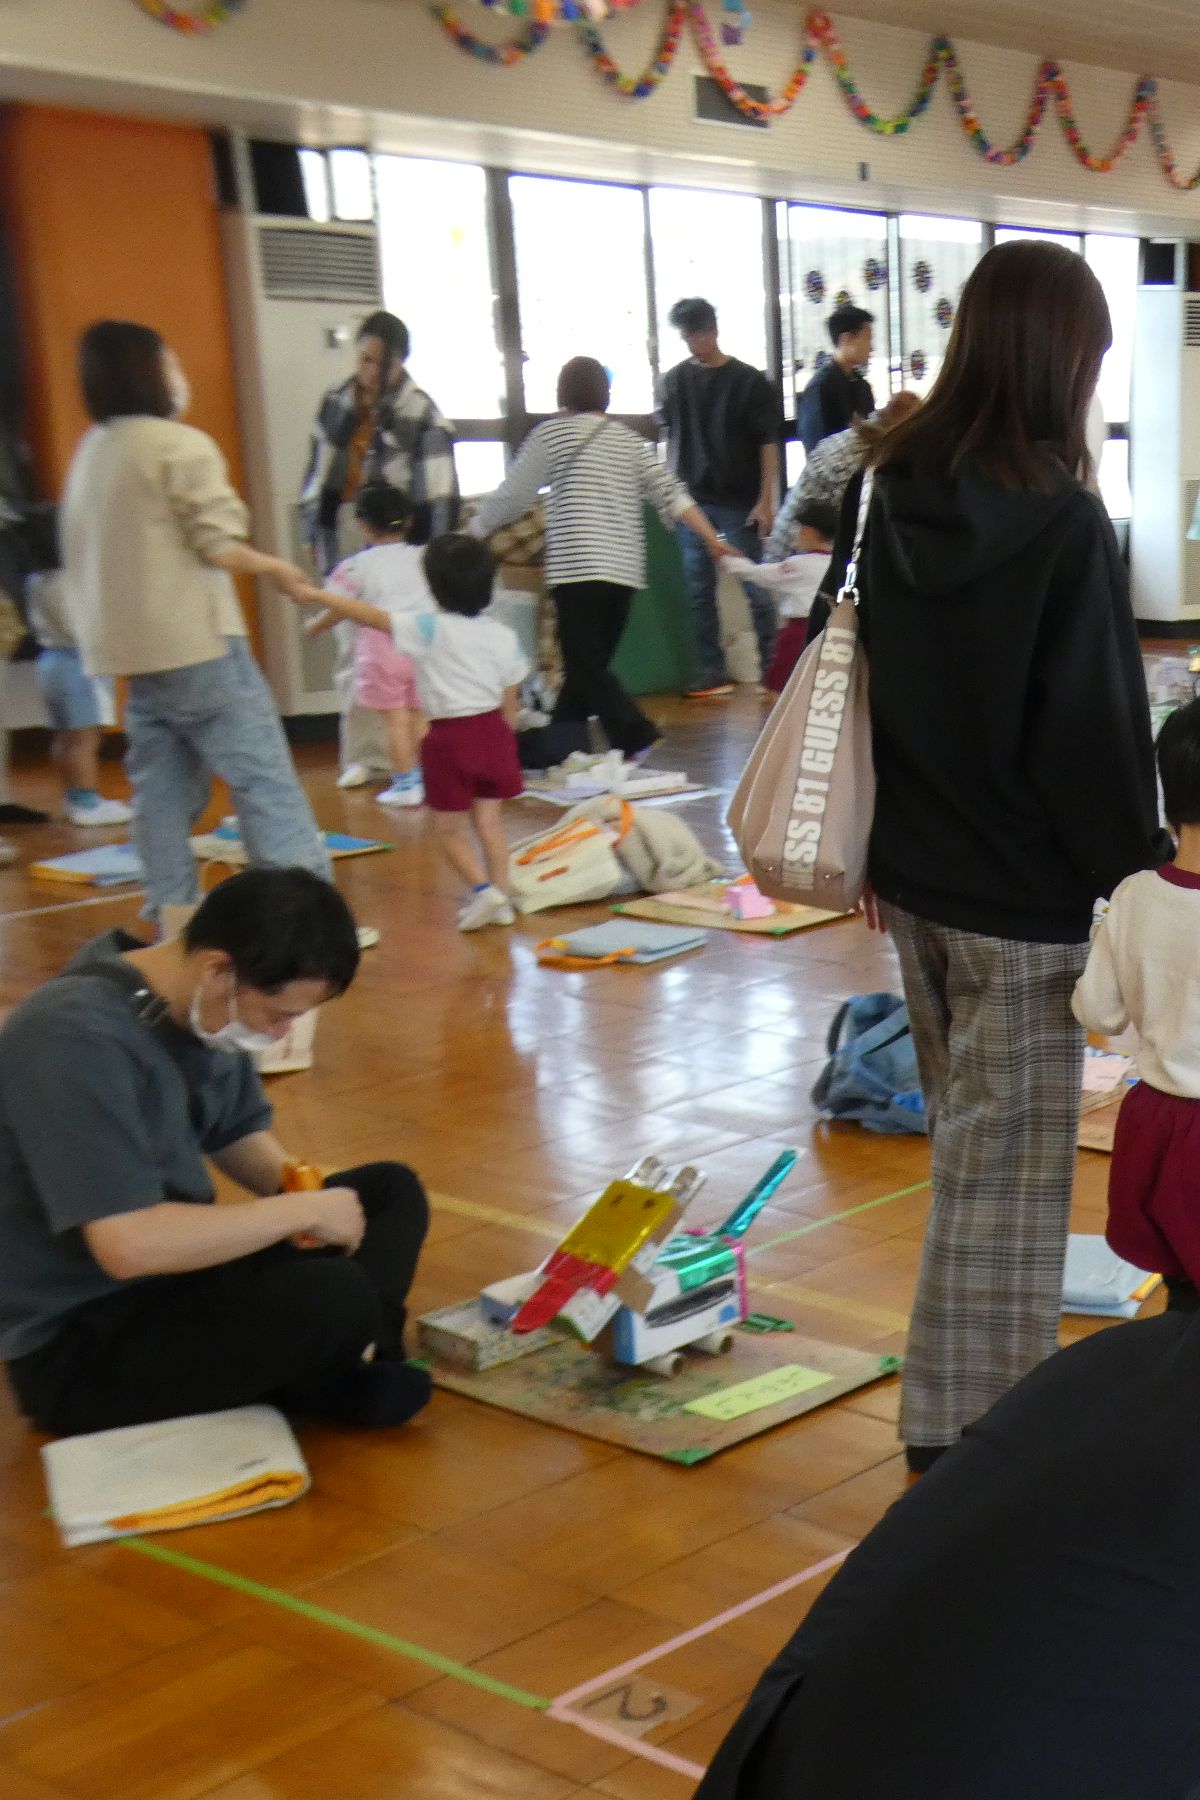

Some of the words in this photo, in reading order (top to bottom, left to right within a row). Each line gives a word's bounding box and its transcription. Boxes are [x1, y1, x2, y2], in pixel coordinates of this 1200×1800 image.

[820, 626, 857, 665] 81
[799, 668, 850, 774] GUESS
[792, 777, 829, 815] 81
[581, 1683, 668, 1722] 2
